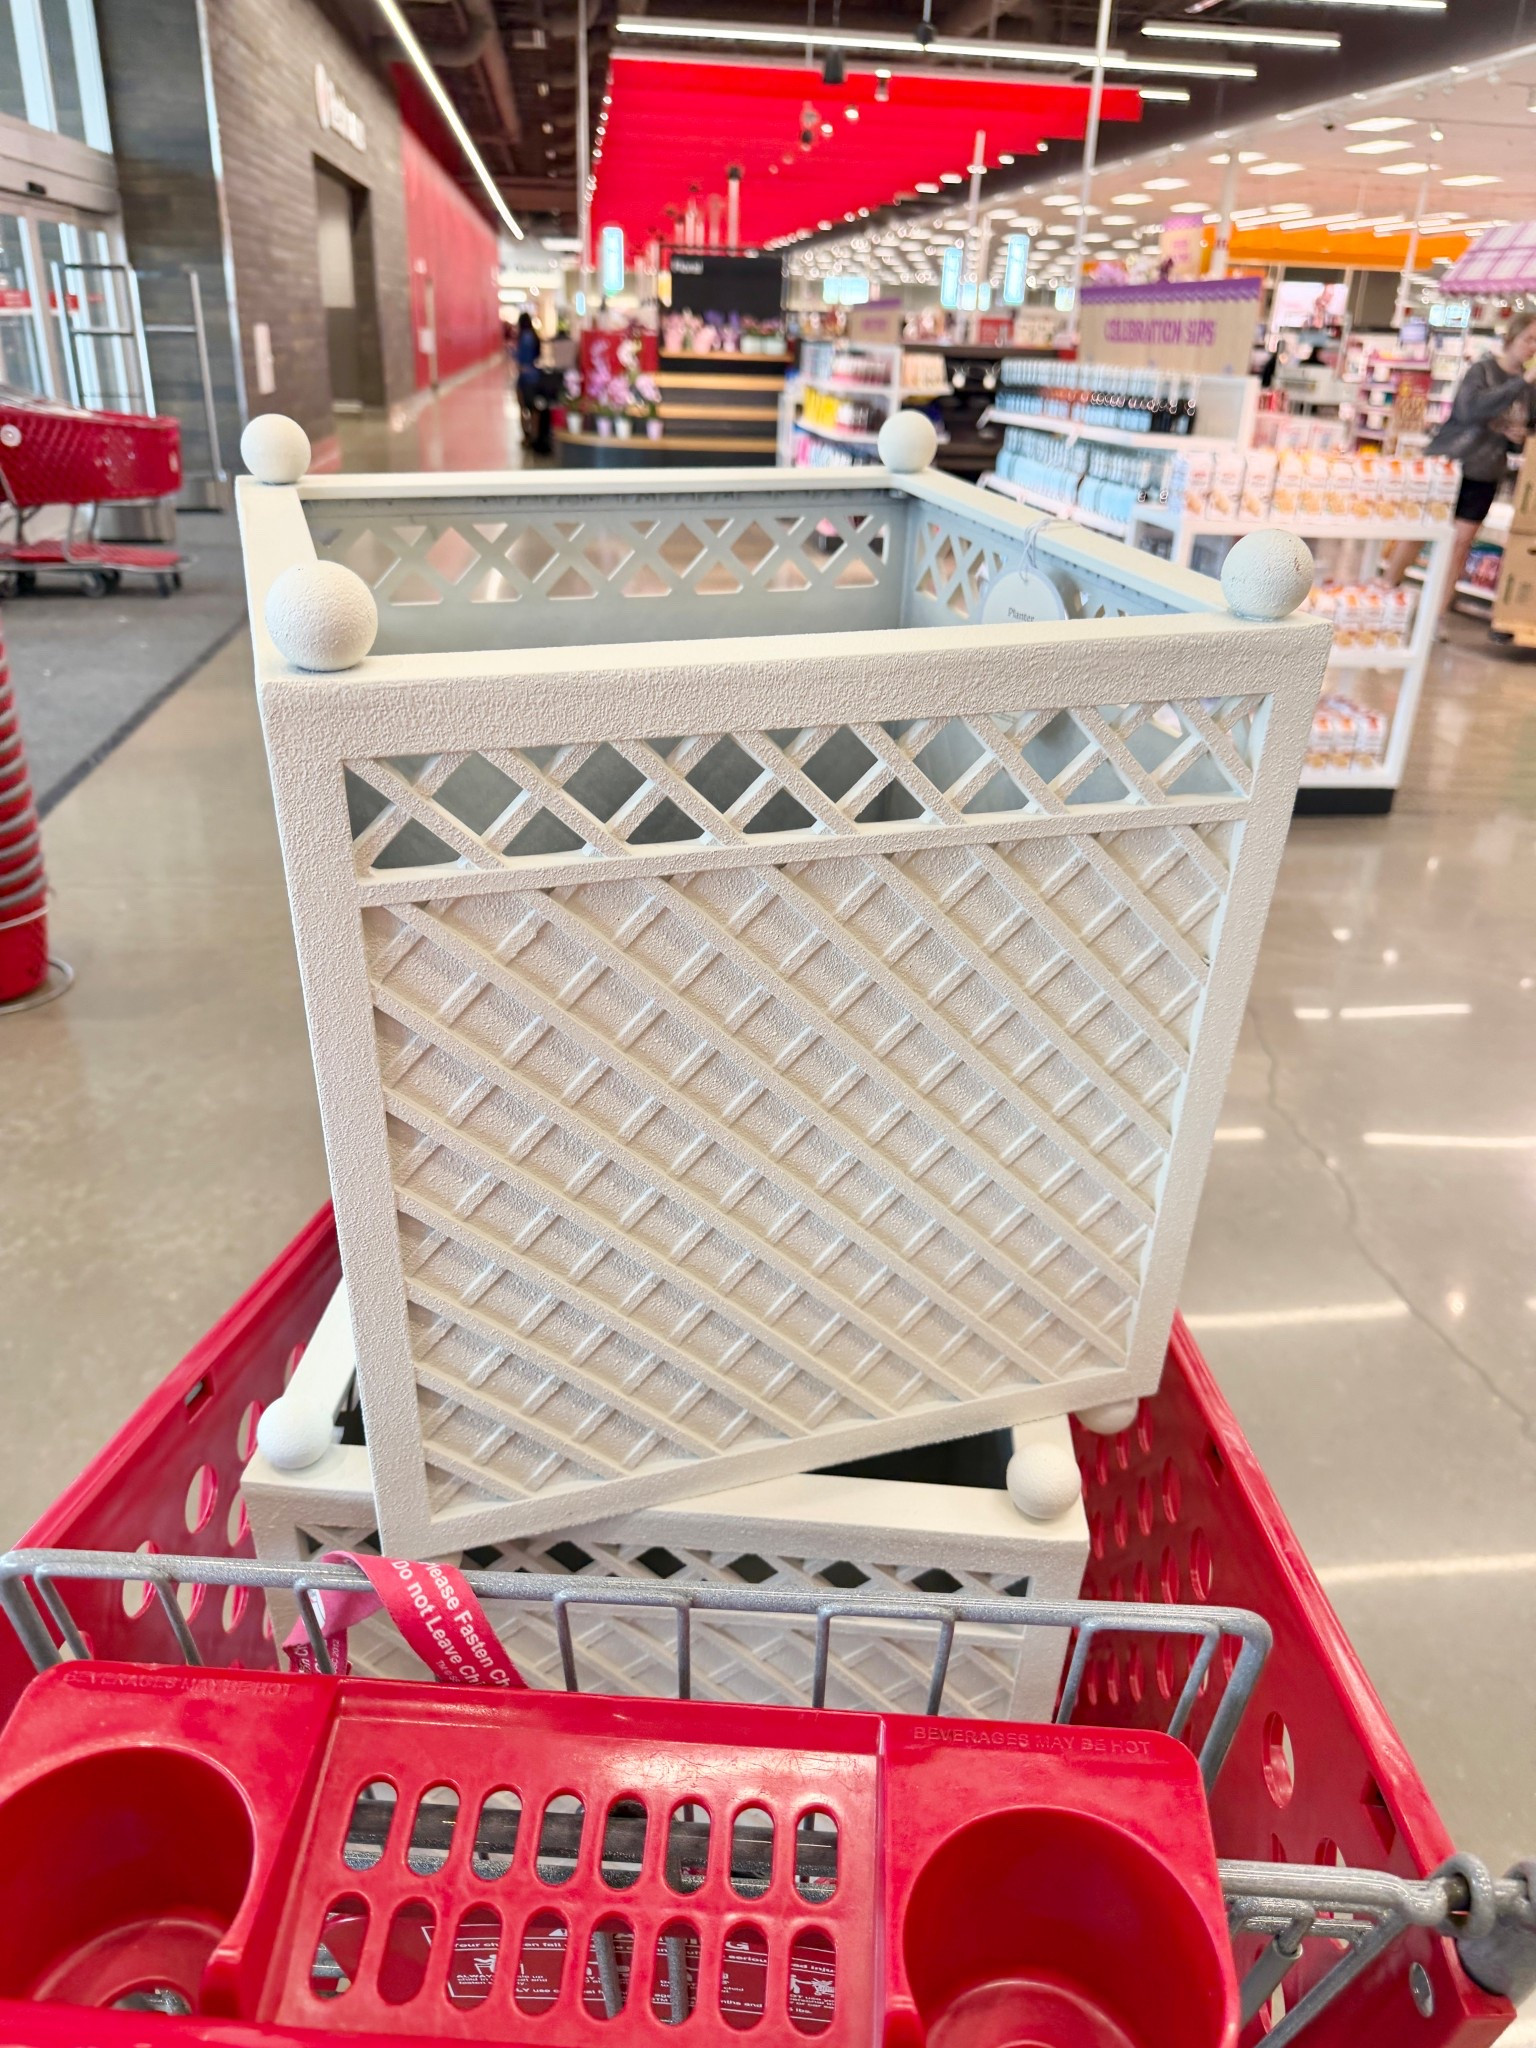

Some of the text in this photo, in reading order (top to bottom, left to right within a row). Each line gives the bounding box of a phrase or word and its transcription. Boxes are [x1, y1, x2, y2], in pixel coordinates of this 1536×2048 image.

[1104, 318, 1215, 347] CELEBRATION SIPS
[1007, 606, 1035, 622] Planter
[391, 1559, 414, 1581] Do
[407, 1581, 436, 1618] not
[425, 1615, 463, 1665] Leave
[454, 1609, 494, 1668] Fasten
[63, 1670, 178, 1689] BEVERAGES
[253, 1682, 291, 1697] HOT
[914, 1726, 1151, 1755] BEVERAGES MAY BE HOT
